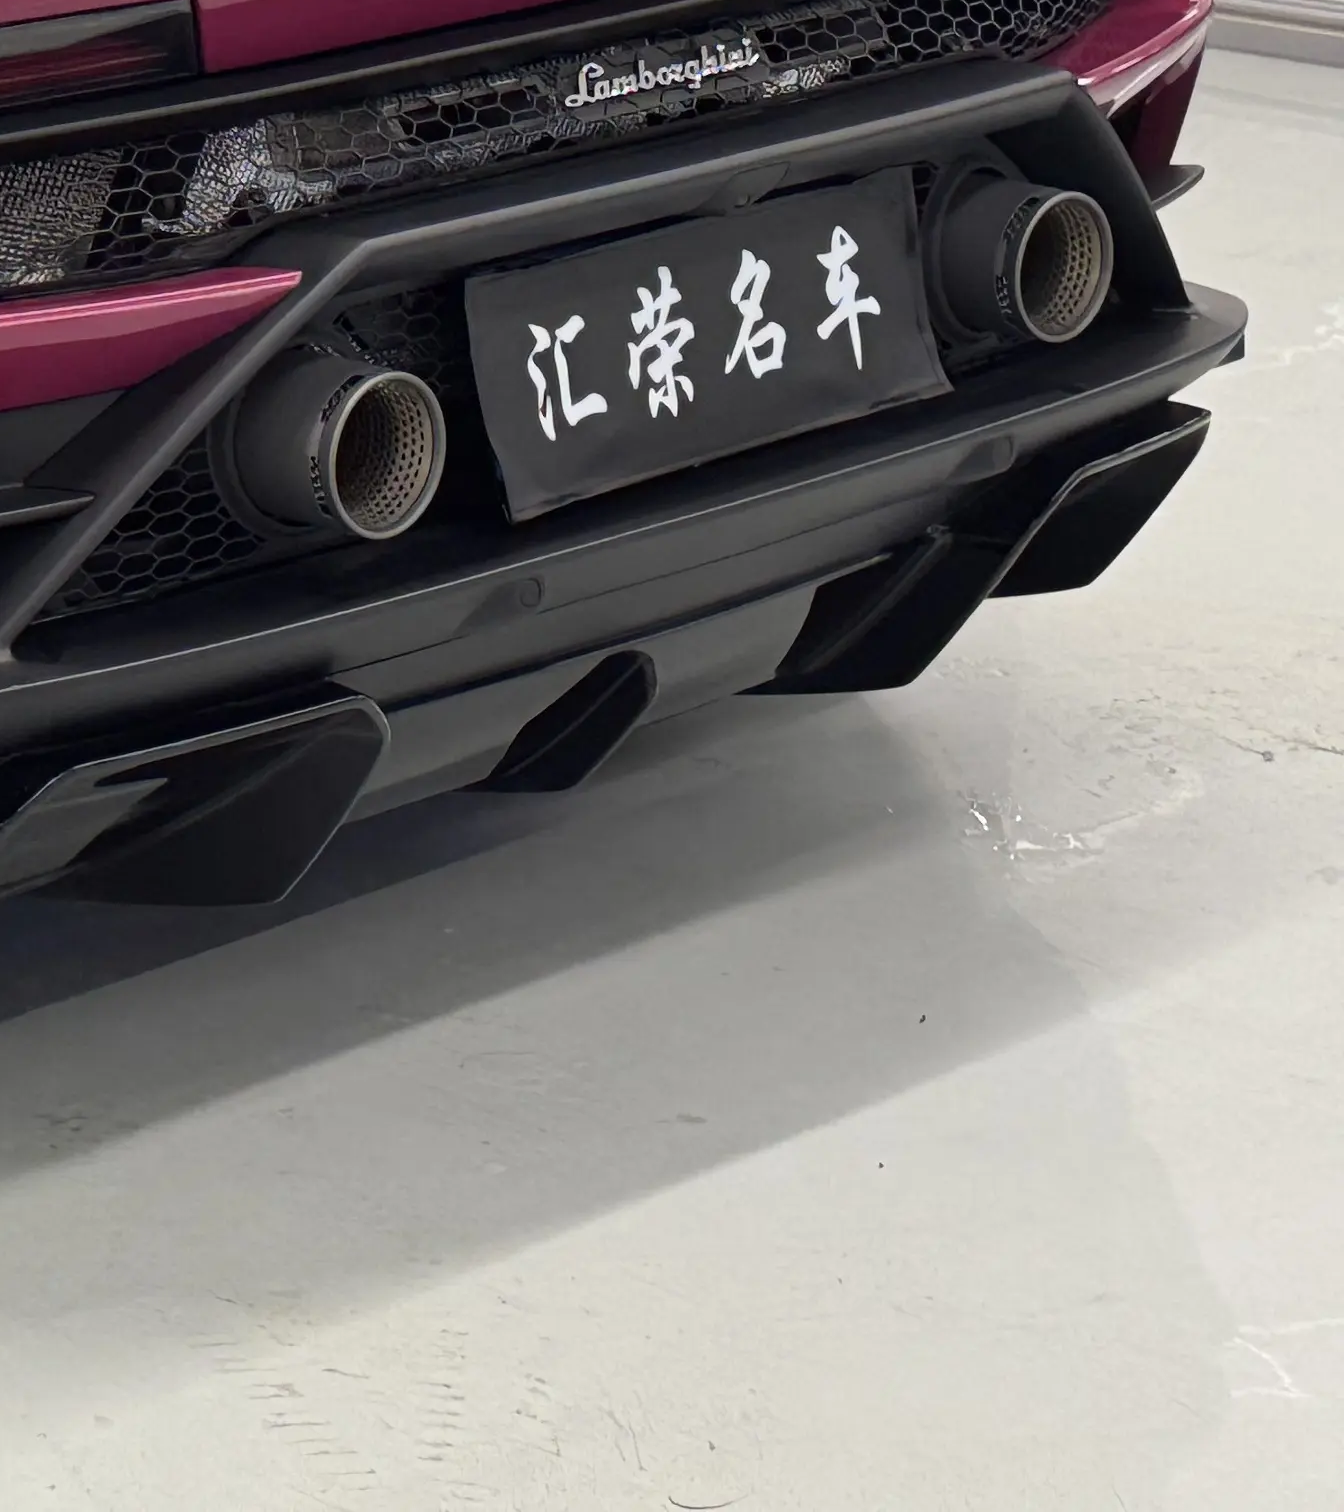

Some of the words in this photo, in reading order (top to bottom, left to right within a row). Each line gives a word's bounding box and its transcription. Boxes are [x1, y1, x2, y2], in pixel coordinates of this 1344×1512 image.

[564, 37, 760, 108] Lamborghini
[526, 225, 881, 441] 汇荣名车
